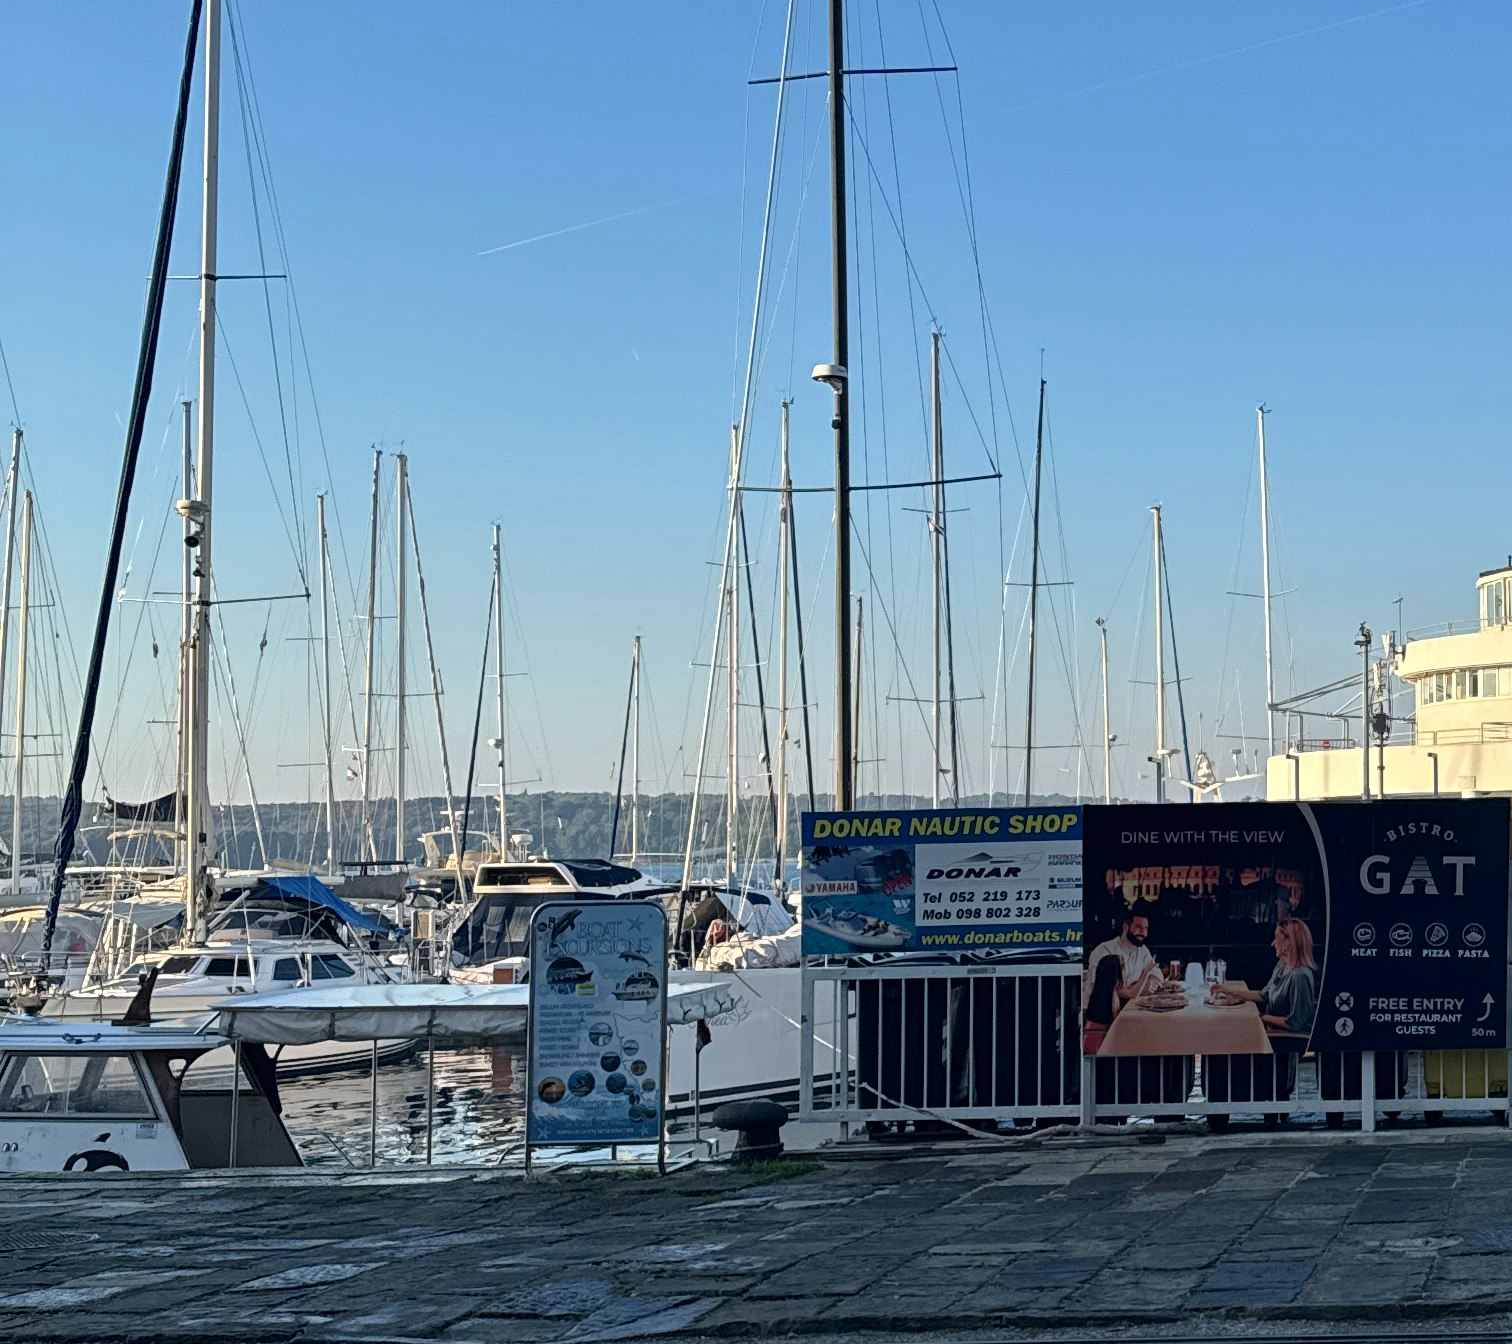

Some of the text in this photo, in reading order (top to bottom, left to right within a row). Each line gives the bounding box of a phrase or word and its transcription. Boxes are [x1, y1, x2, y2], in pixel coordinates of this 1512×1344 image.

[813, 814, 1078, 838] DONAR NAUTIC SHOP
[1385, 822, 1455, 842] BISTRO
[1121, 830, 1285, 844] DINE WITH THE VIEW
[926, 867, 1022, 880] DONAR
[1359, 855, 1476, 896] GAT
[816, 882, 856, 893] YAMAHA
[922, 889, 1041, 904] Tel 052 219 173
[922, 906, 1041, 921] Mob 098 802 328
[577, 921, 622, 939] BOAT
[921, 928, 1083, 946] www.donarboats.hr
[546, 937, 651, 957] EXCURSIONS
[1351, 948, 1490, 958] MEAT FISH PIZZA PASTA
[1368, 997, 1465, 1010] FREE ENTRY
[1369, 1013, 1462, 1023] FOR RESTAURANT
[1395, 1025, 1436, 1035] GUESTS
[1471, 1027, 1497, 1037] 50 m
